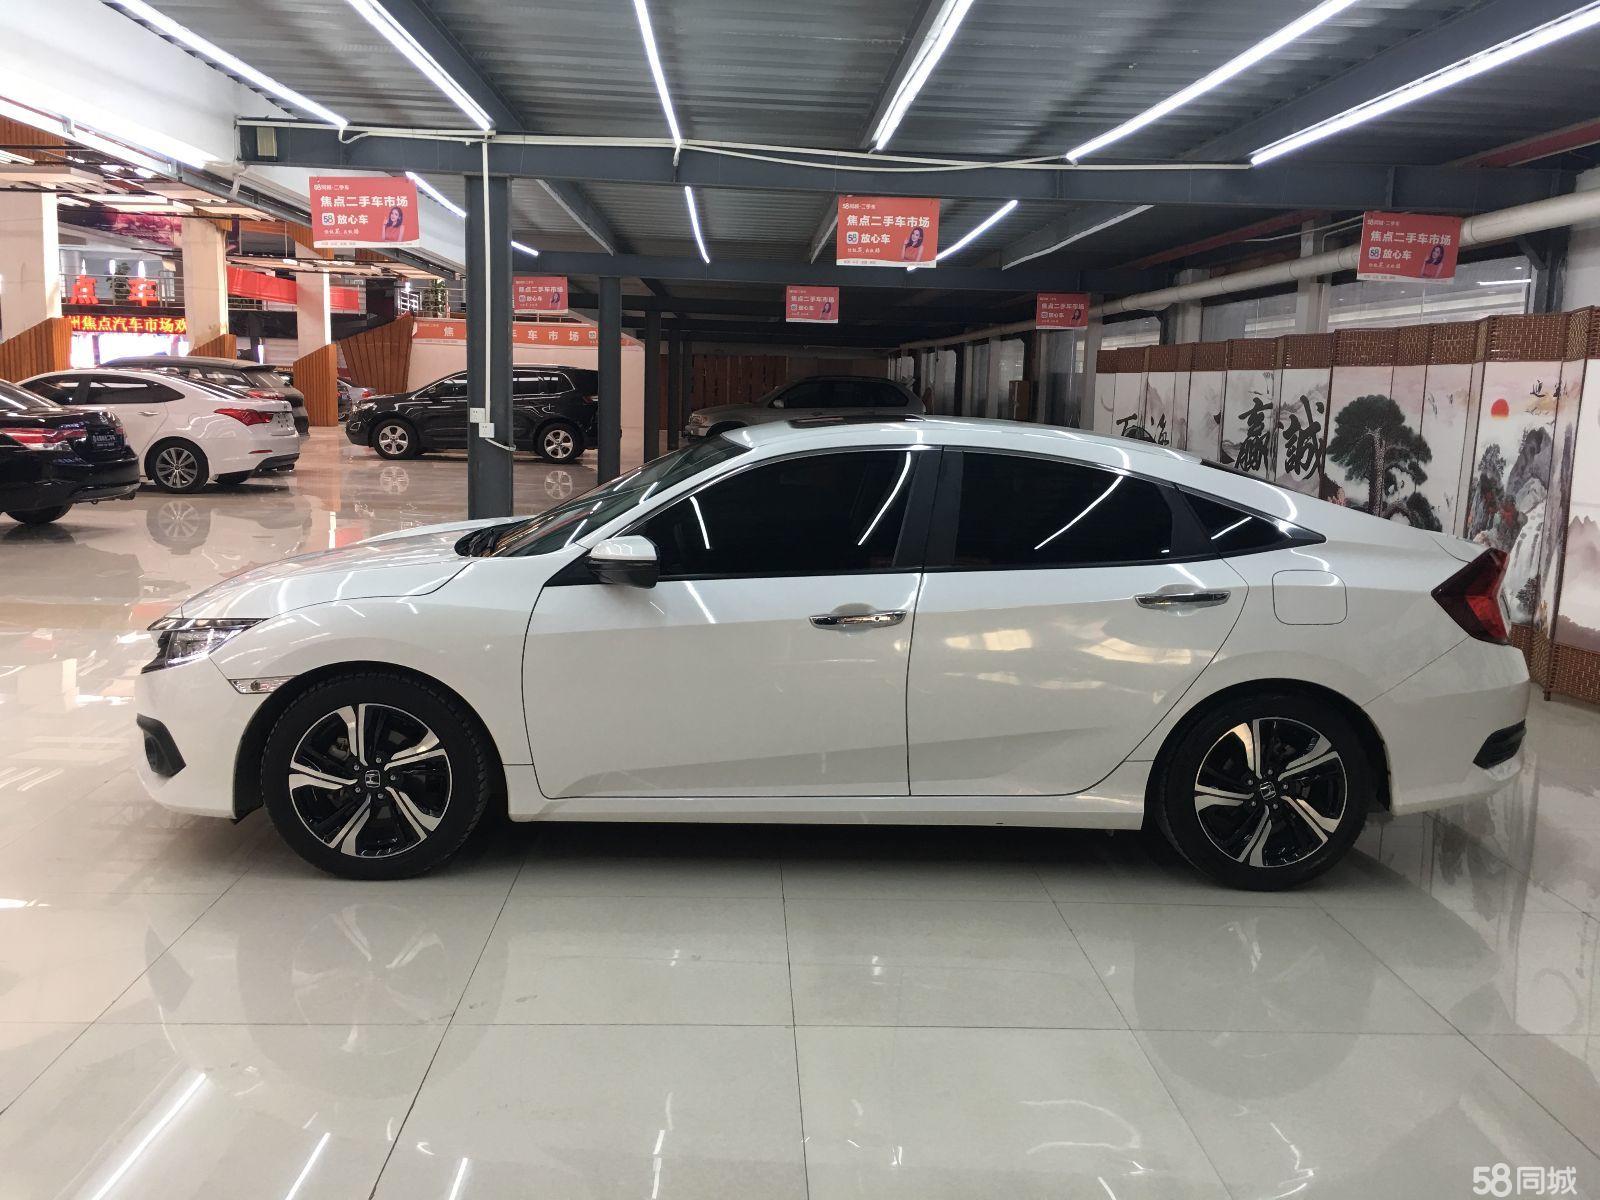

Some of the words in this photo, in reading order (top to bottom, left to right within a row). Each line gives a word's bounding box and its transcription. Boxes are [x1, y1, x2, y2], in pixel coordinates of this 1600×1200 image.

[320, 195, 409, 208] 焦点二手车市场
[337, 214, 369, 225] 放心车
[846, 214, 931, 229] 焦点二手车市场
[860, 233, 891, 245] 放心车
[1370, 230, 1452, 247] 焦点二手车市场
[1382, 249, 1413, 261] 放心车
